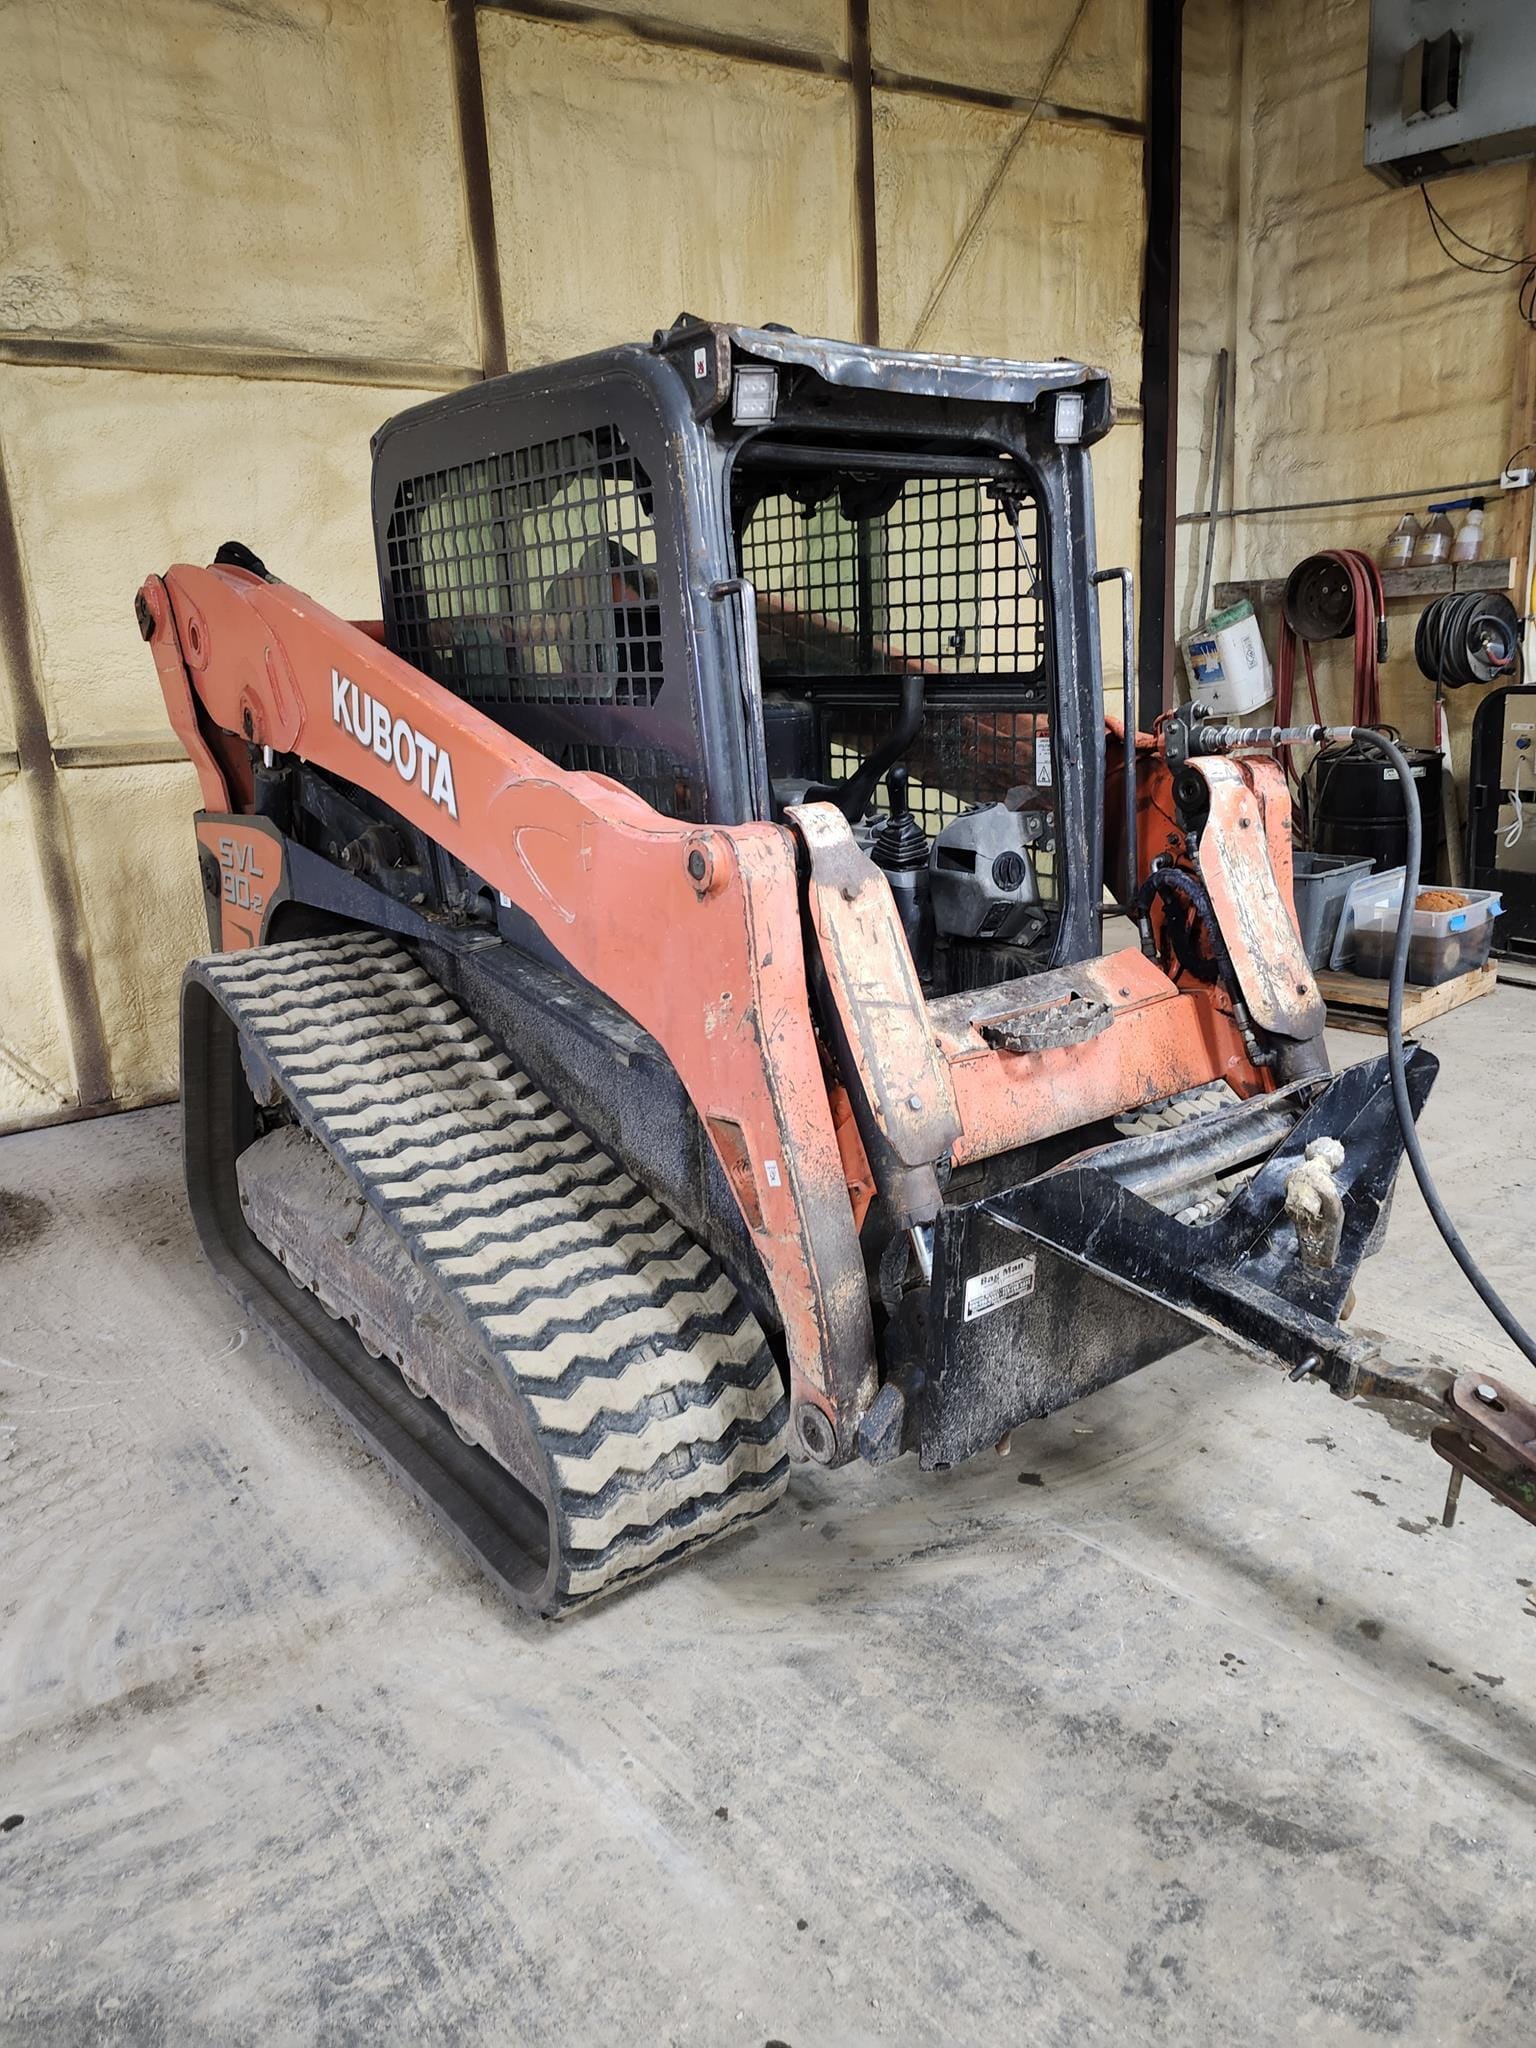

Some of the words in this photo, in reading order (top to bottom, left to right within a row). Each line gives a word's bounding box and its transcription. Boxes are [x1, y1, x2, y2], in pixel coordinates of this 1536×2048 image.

[331, 667, 458, 820] KUBOTA
[219, 837, 264, 879] SVL
[1003, 1262, 1024, 1275] Man
